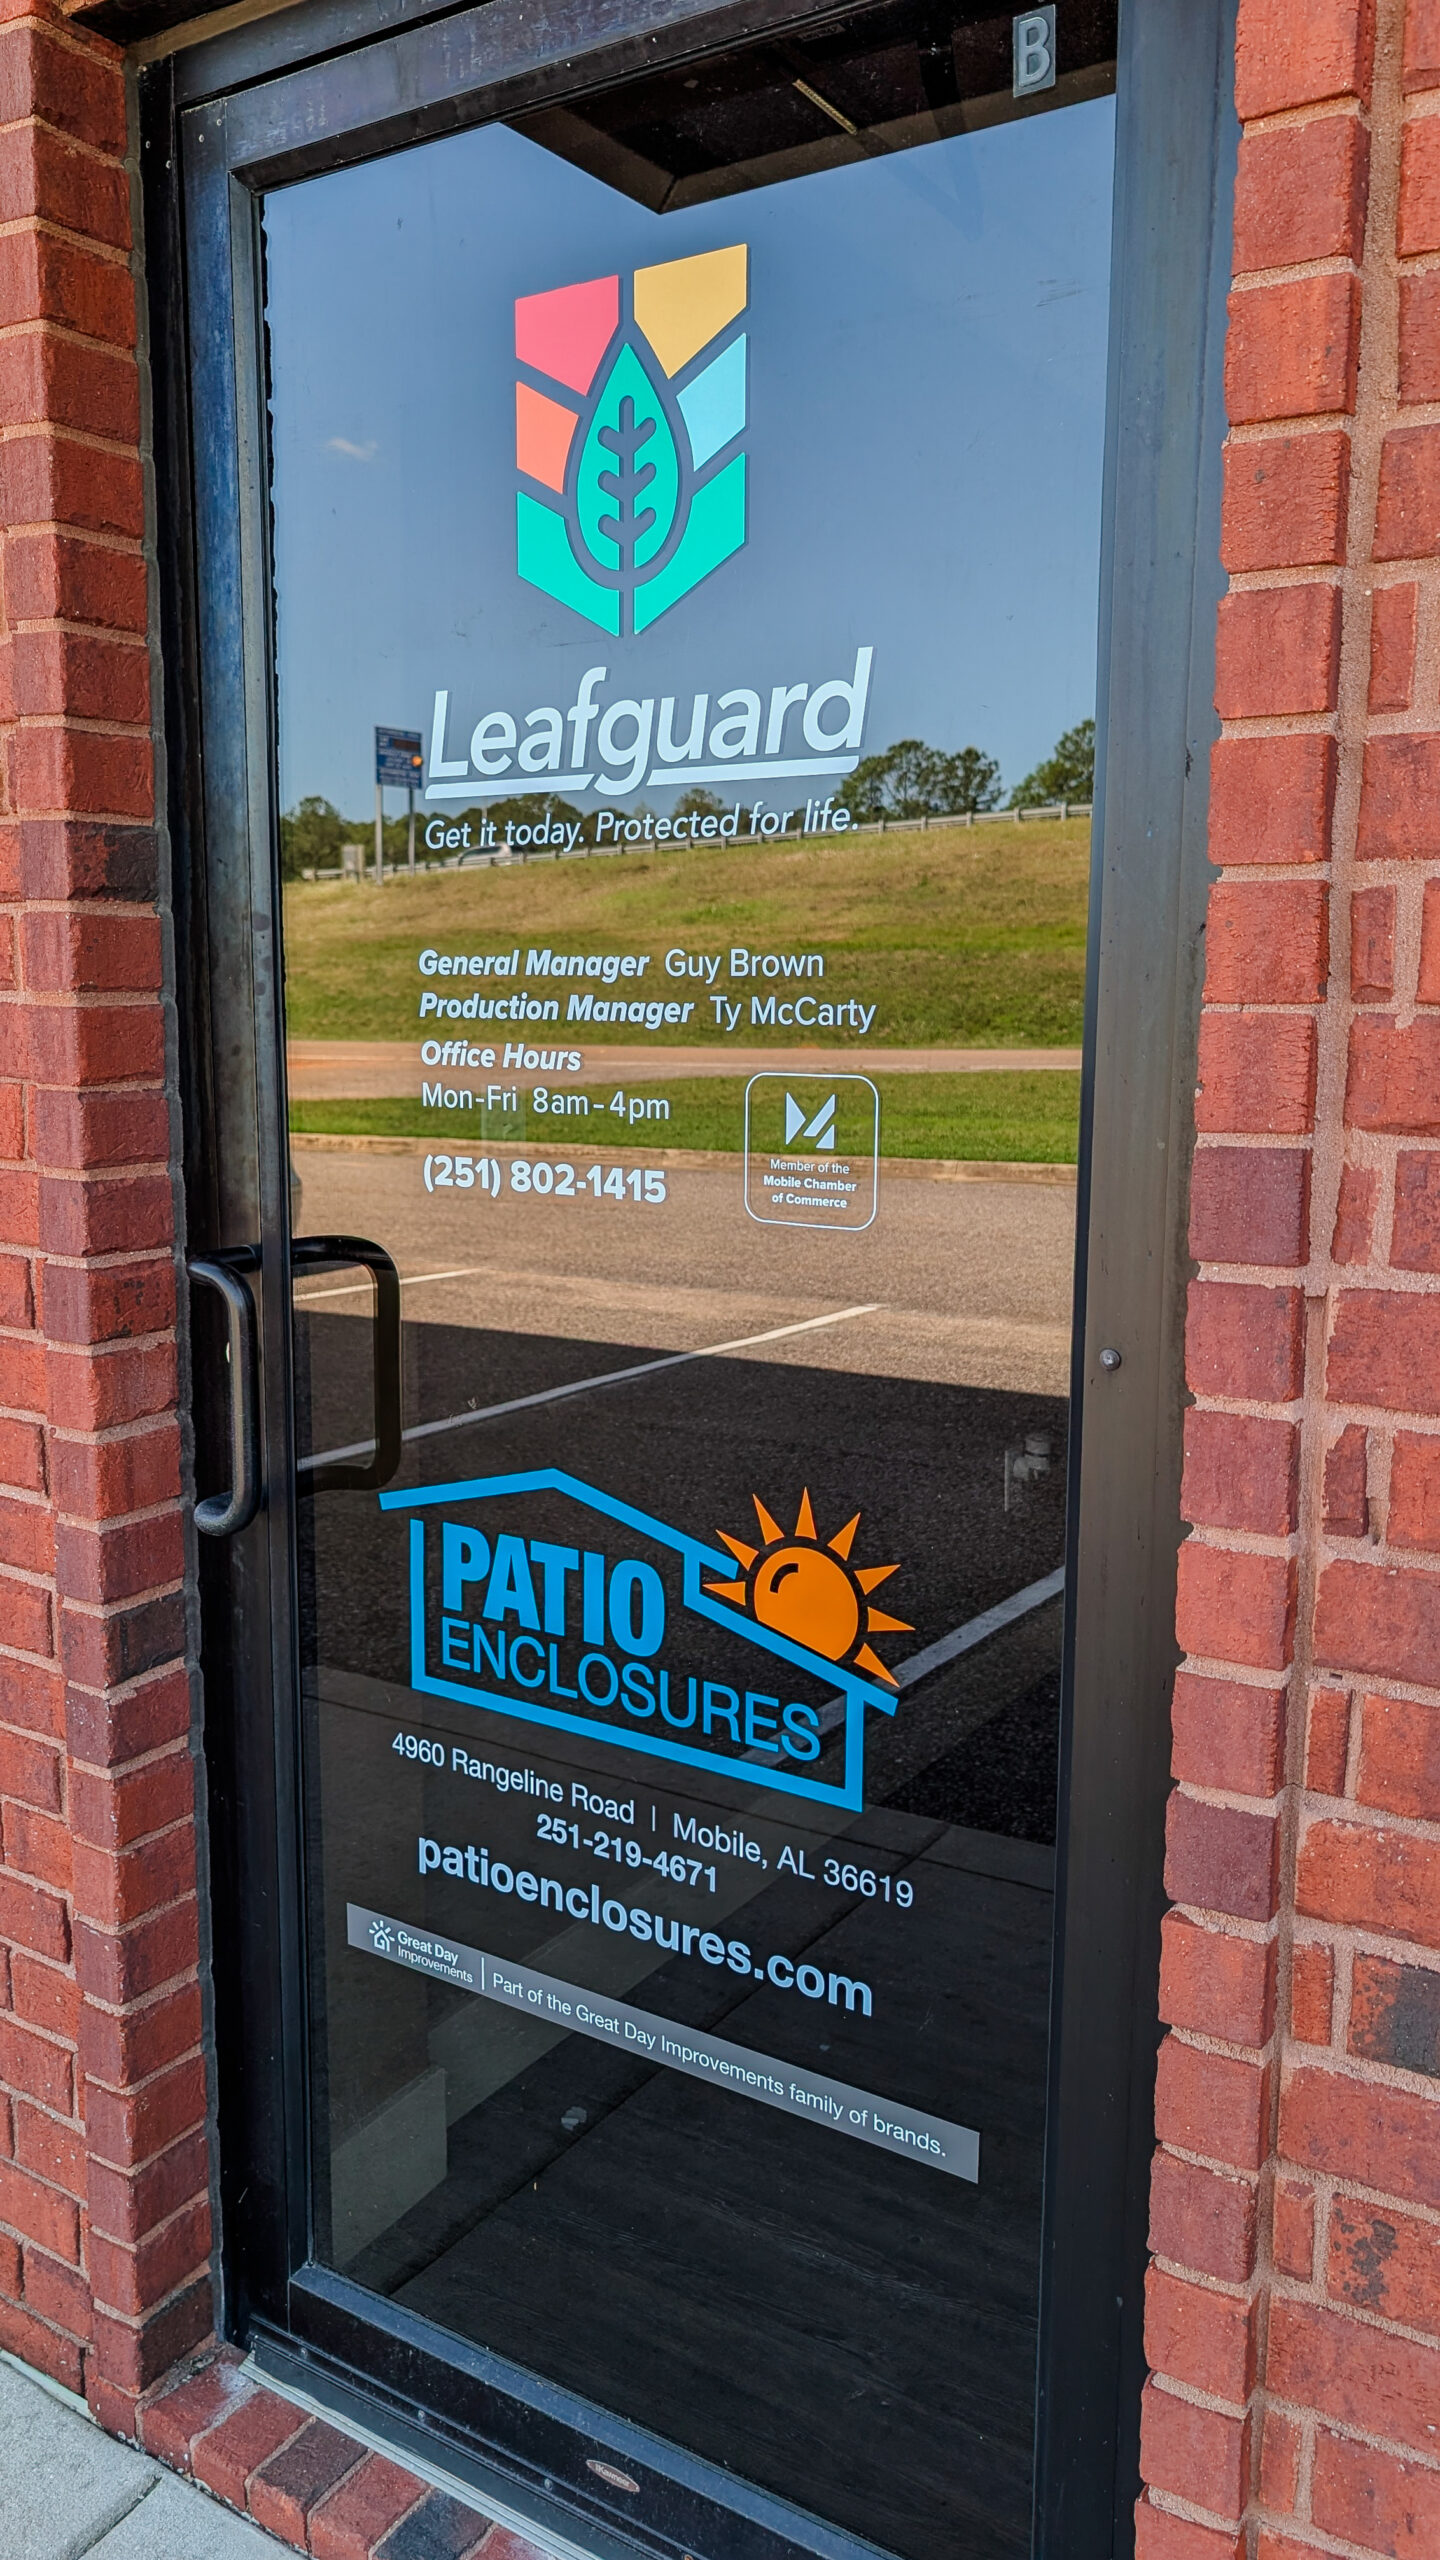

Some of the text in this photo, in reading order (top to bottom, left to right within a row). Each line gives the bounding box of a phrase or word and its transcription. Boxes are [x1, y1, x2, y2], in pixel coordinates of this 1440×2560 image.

[1018, 16, 1051, 88] B
[428, 646, 873, 796] Leafguard
[425, 796, 859, 852] Get it today. Protected for life.
[418, 948, 824, 984] General Manager Guy Brown
[418, 992, 877, 1034] Production Manager Ty McCarty
[420, 1040, 582, 1072] Office Hours
[422, 1082, 518, 1112] Mon-Fri
[423, 1153, 667, 1204] (251) 802-1415
[763, 1175, 857, 1192] Mobile Chamber
[770, 1158, 850, 1174] Member of the
[771, 1193, 847, 1208] of Commerce
[442, 1521, 666, 1658] PATIO
[442, 1616, 822, 1761] ENCLOSURES
[391, 1732, 914, 1908] 4960 Rangeline Road Mobile, AL 36619
[536, 1813, 717, 1893] 251-219-4671
[397, 1930, 459, 1967] Great Day
[418, 1836, 873, 2017] patioenclosures.com
[397, 1946, 473, 1983] Improvements
[493, 1972, 947, 2157] Part of the Great Day Improvements family of brands.
